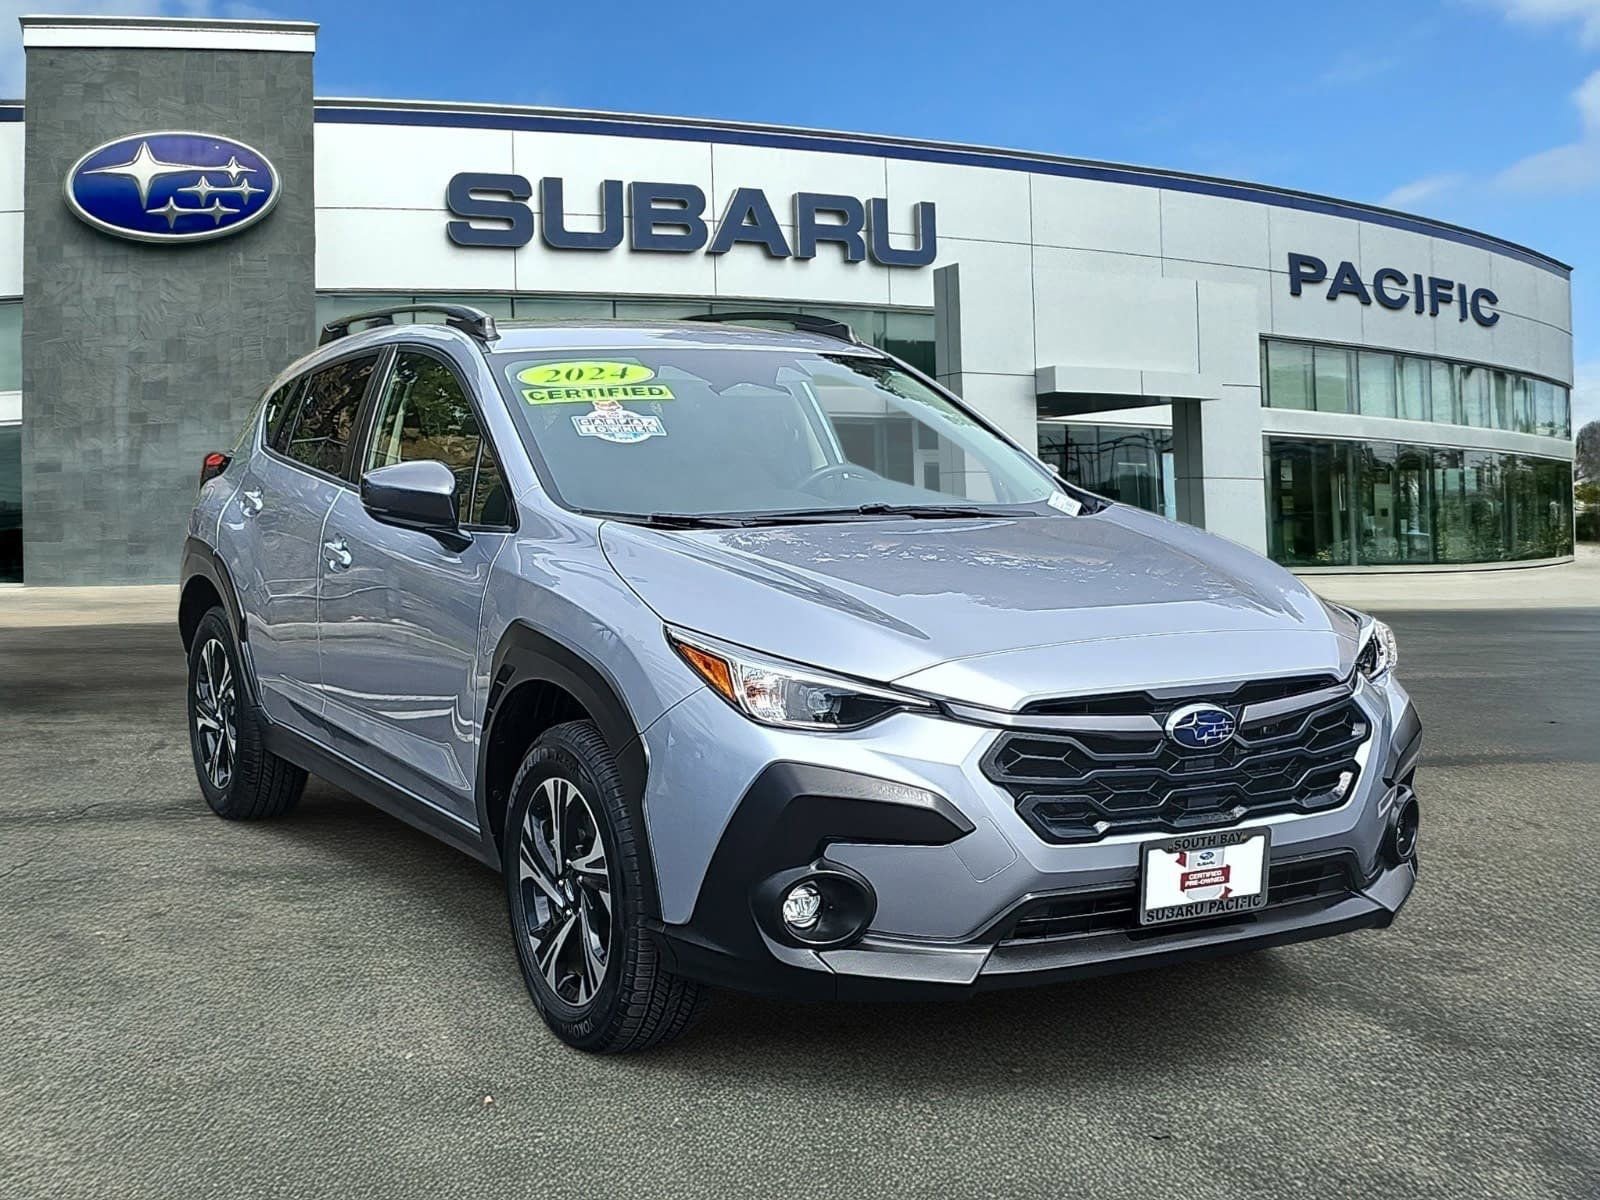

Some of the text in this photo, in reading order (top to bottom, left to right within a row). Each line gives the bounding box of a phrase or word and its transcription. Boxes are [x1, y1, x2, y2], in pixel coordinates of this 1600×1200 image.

[446, 172, 937, 268] SUBARU
[1288, 251, 1500, 327] PACIFIC
[544, 366, 629, 383] 2024
[528, 386, 664, 401] CERTIFIED
[1174, 832, 1243, 851] SOUTH BAY
[1185, 876, 1225, 888] PRE-OWNED
[1189, 870, 1222, 880] CERTIFIED
[1146, 894, 1262, 923] SUBARU PACIFIC
